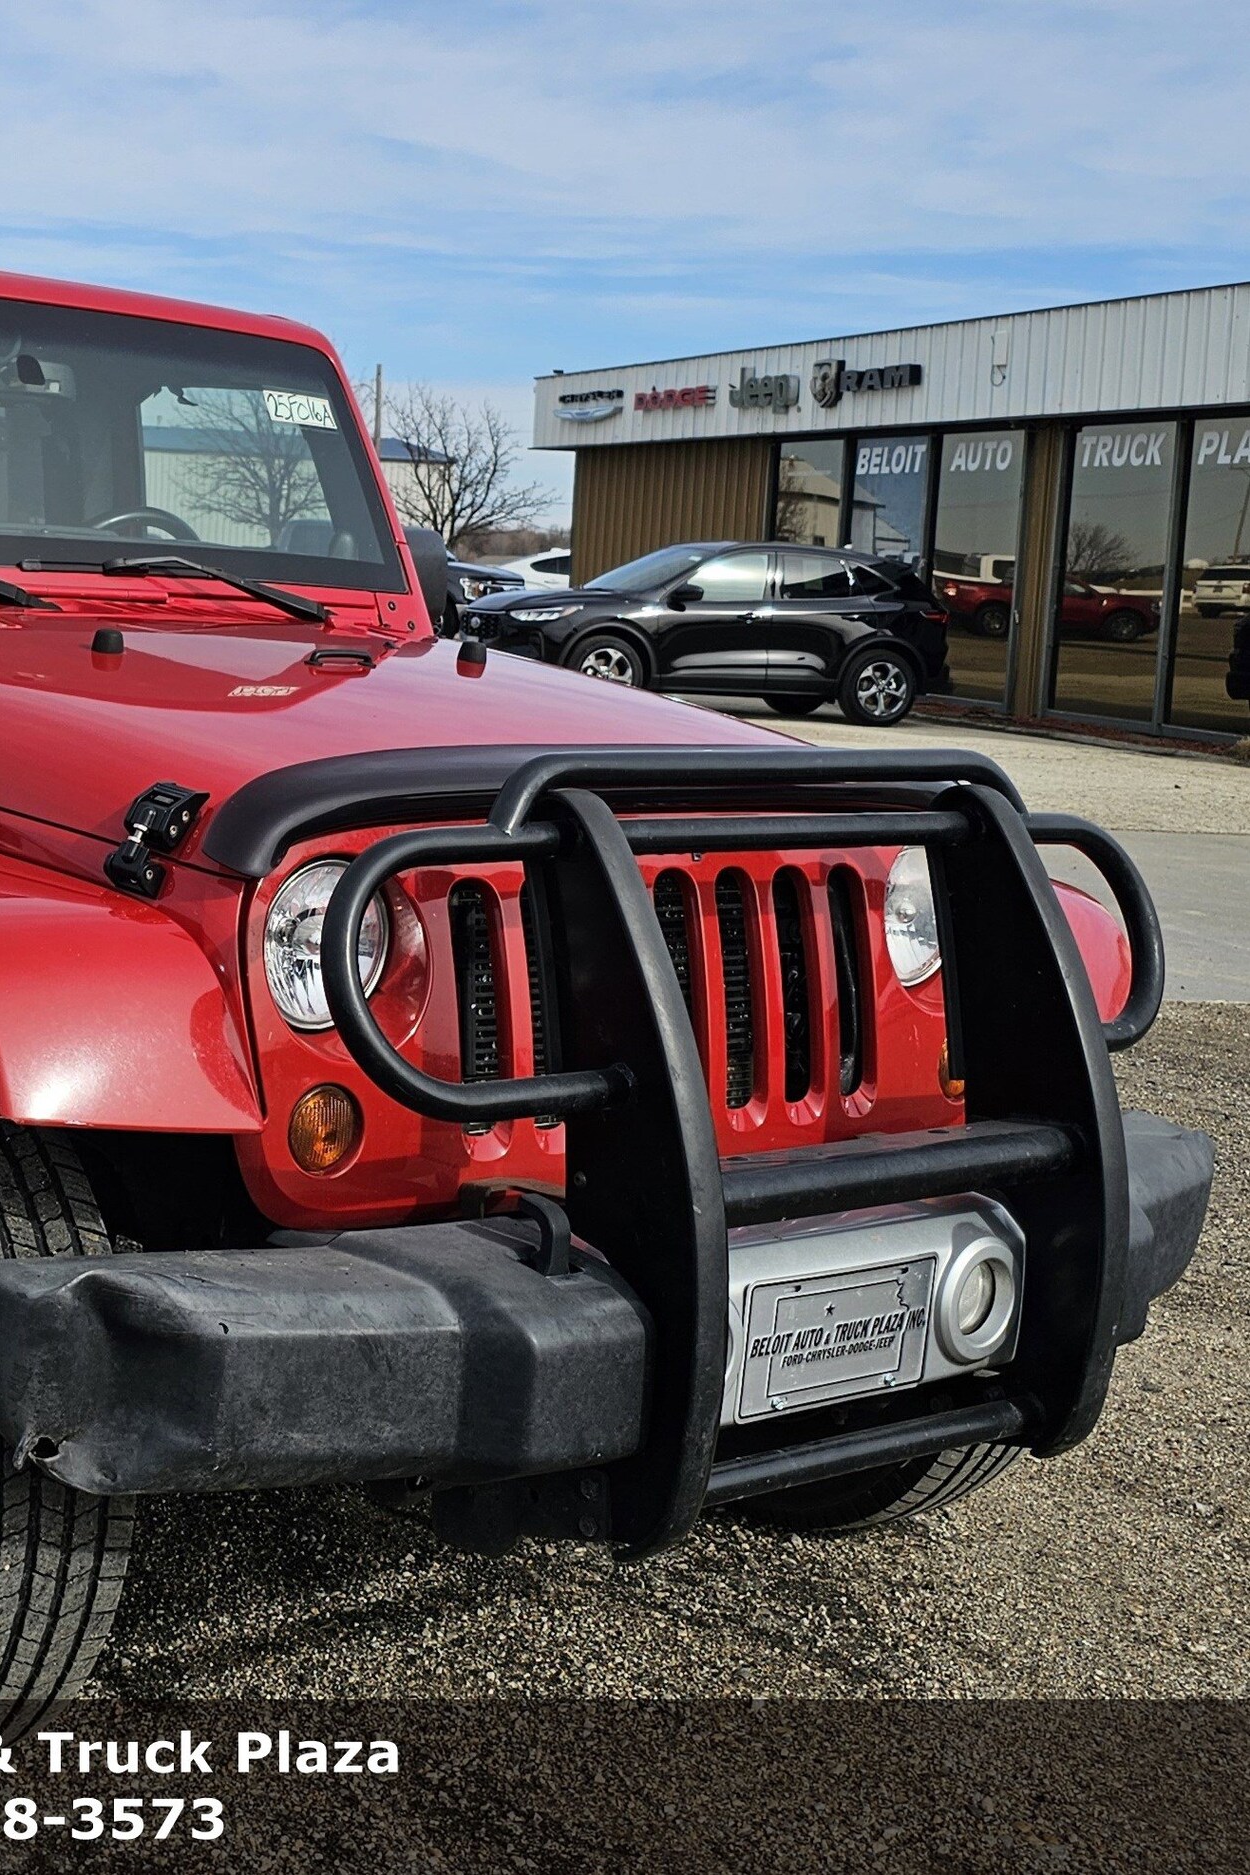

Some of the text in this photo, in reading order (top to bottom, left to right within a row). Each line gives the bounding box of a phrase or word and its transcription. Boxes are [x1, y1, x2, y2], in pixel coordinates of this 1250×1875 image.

[634, 385, 713, 411] DODGE
[729, 367, 797, 414] Jeep
[840, 364, 916, 393] RAM
[856, 444, 927, 475] BELOIT
[950, 440, 1013, 472] AUTO
[1081, 432, 1168, 467] TRUCK
[750, 1307, 926, 1359] BELOIT AUTO & TRUCK PLAZA INC.
